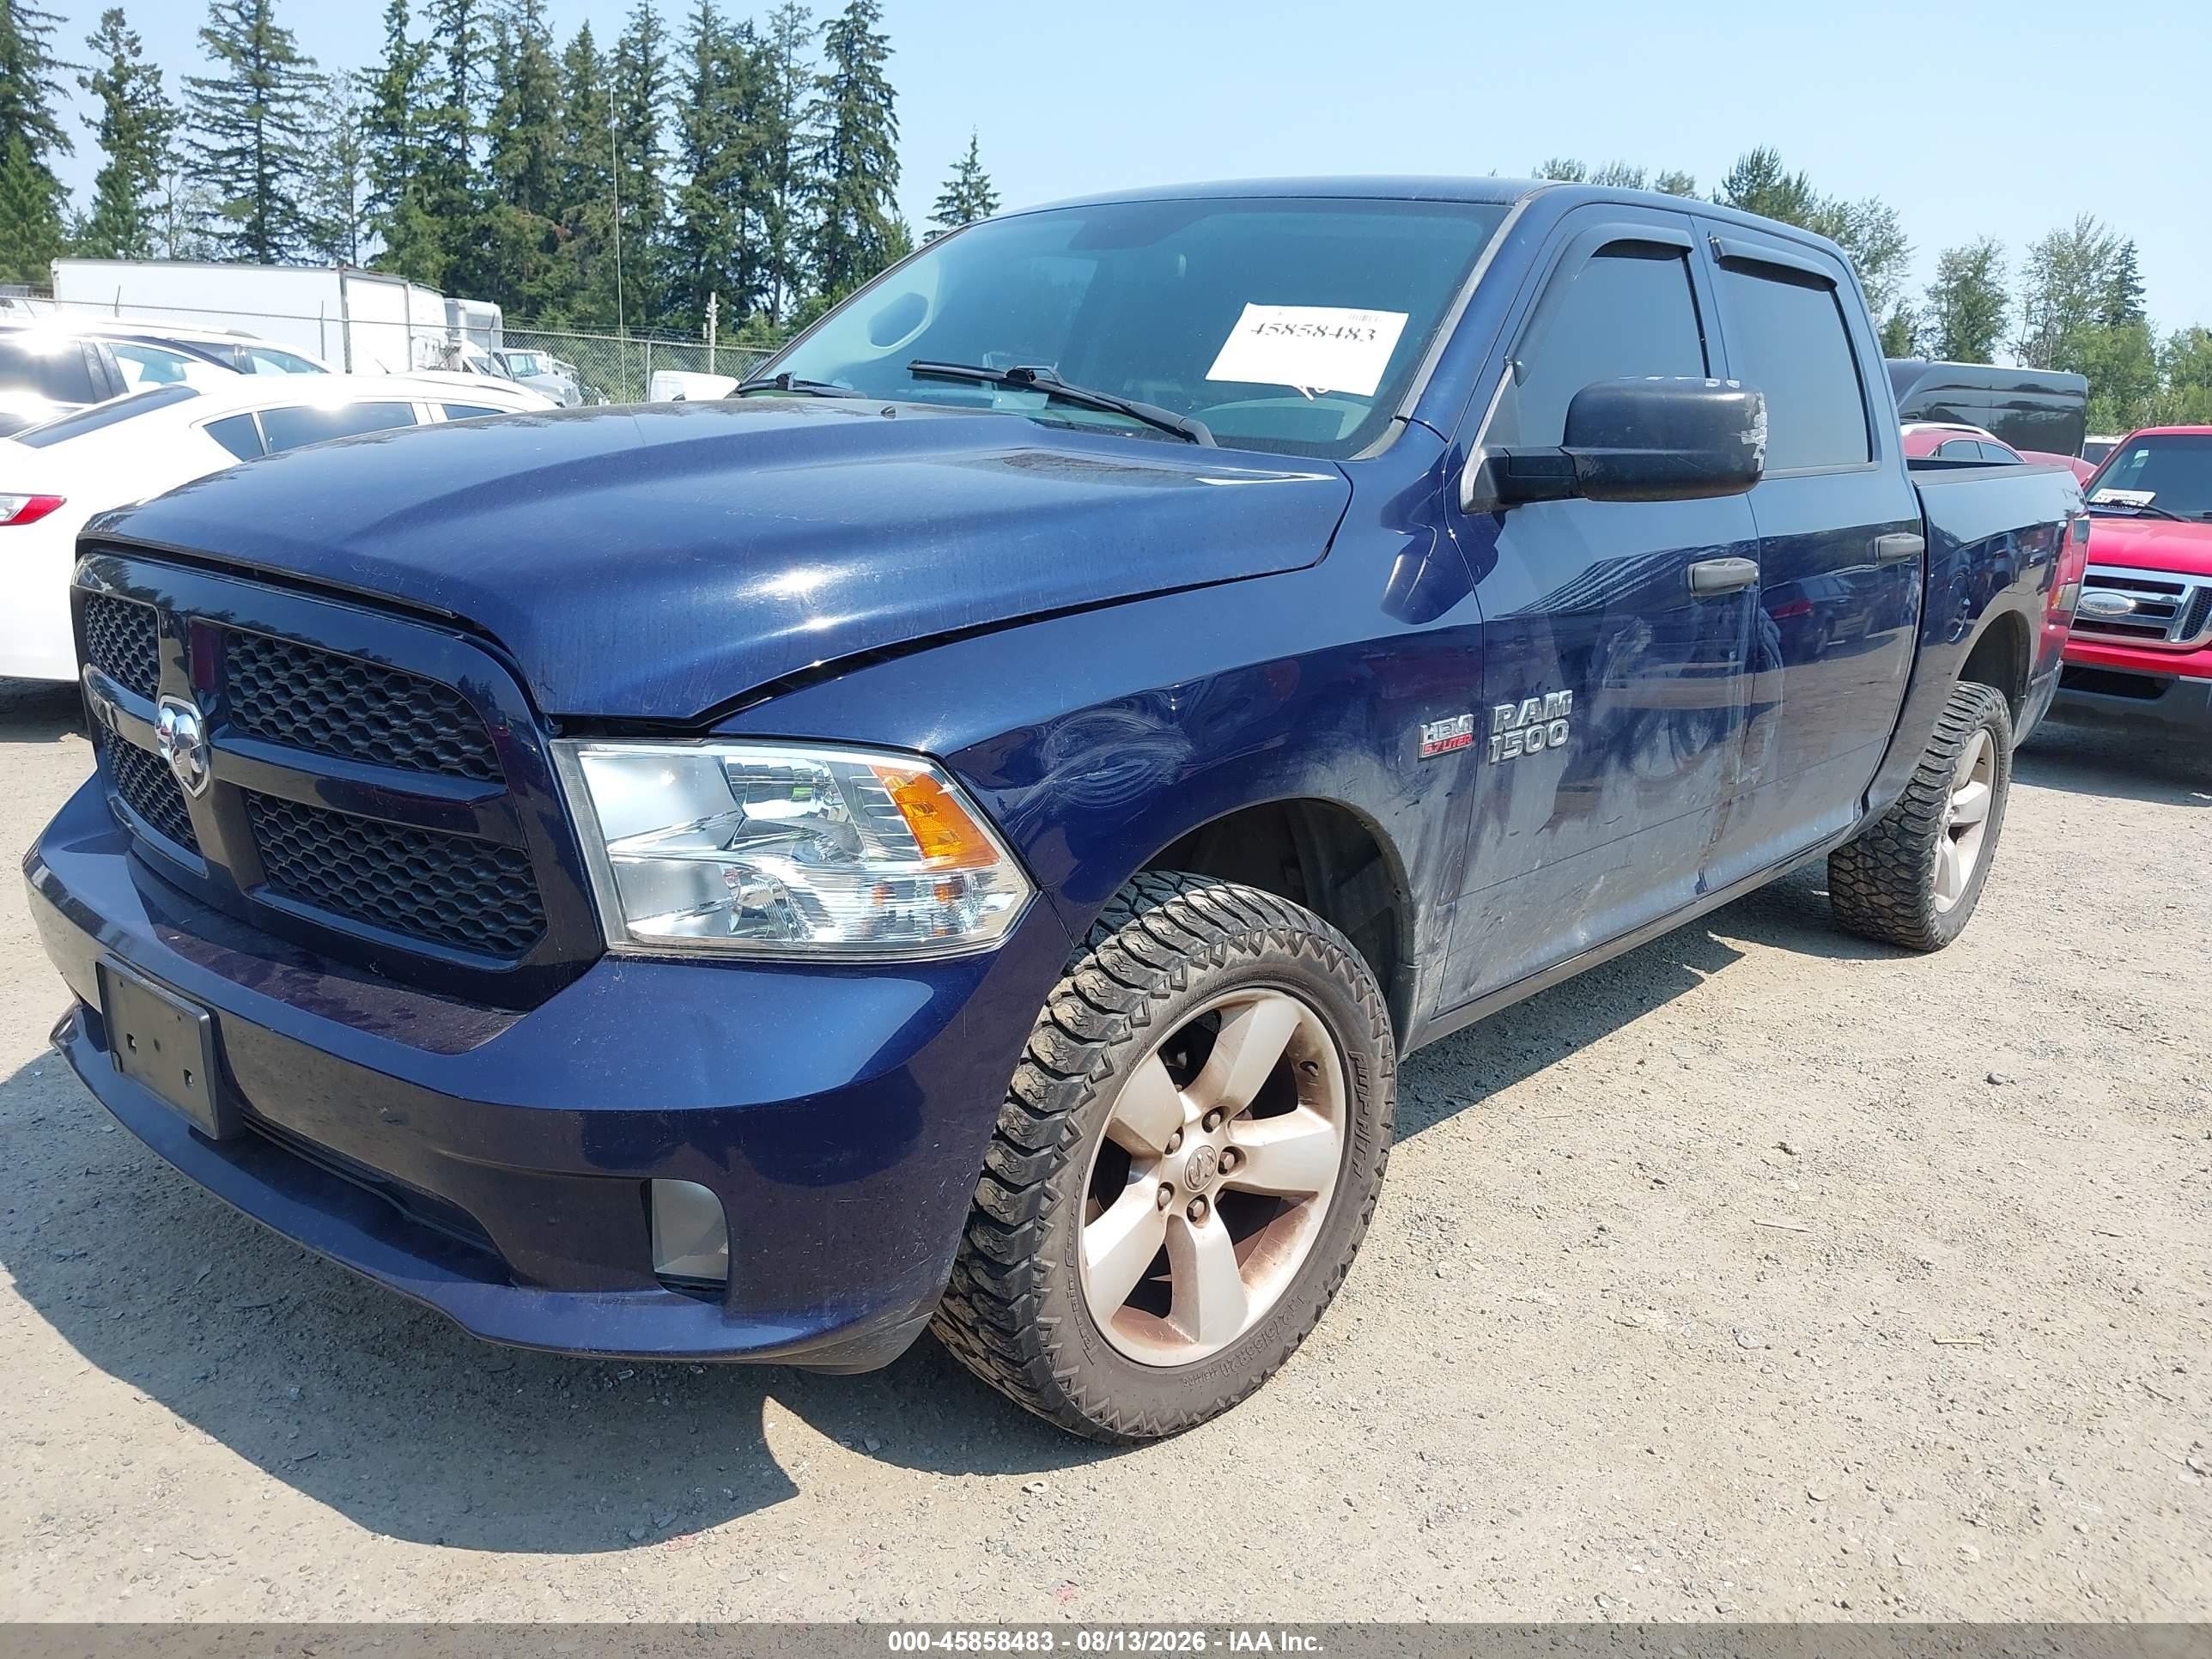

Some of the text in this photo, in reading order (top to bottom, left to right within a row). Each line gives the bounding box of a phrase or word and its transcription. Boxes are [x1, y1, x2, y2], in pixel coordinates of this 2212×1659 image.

[1250, 322, 1376, 342] 45858483
[1492, 690, 1573, 733] RAM
[1419, 714, 1474, 744] HEMI
[1423, 733, 1472, 755] 5.7 LITER
[1489, 719, 1570, 763] 1500
